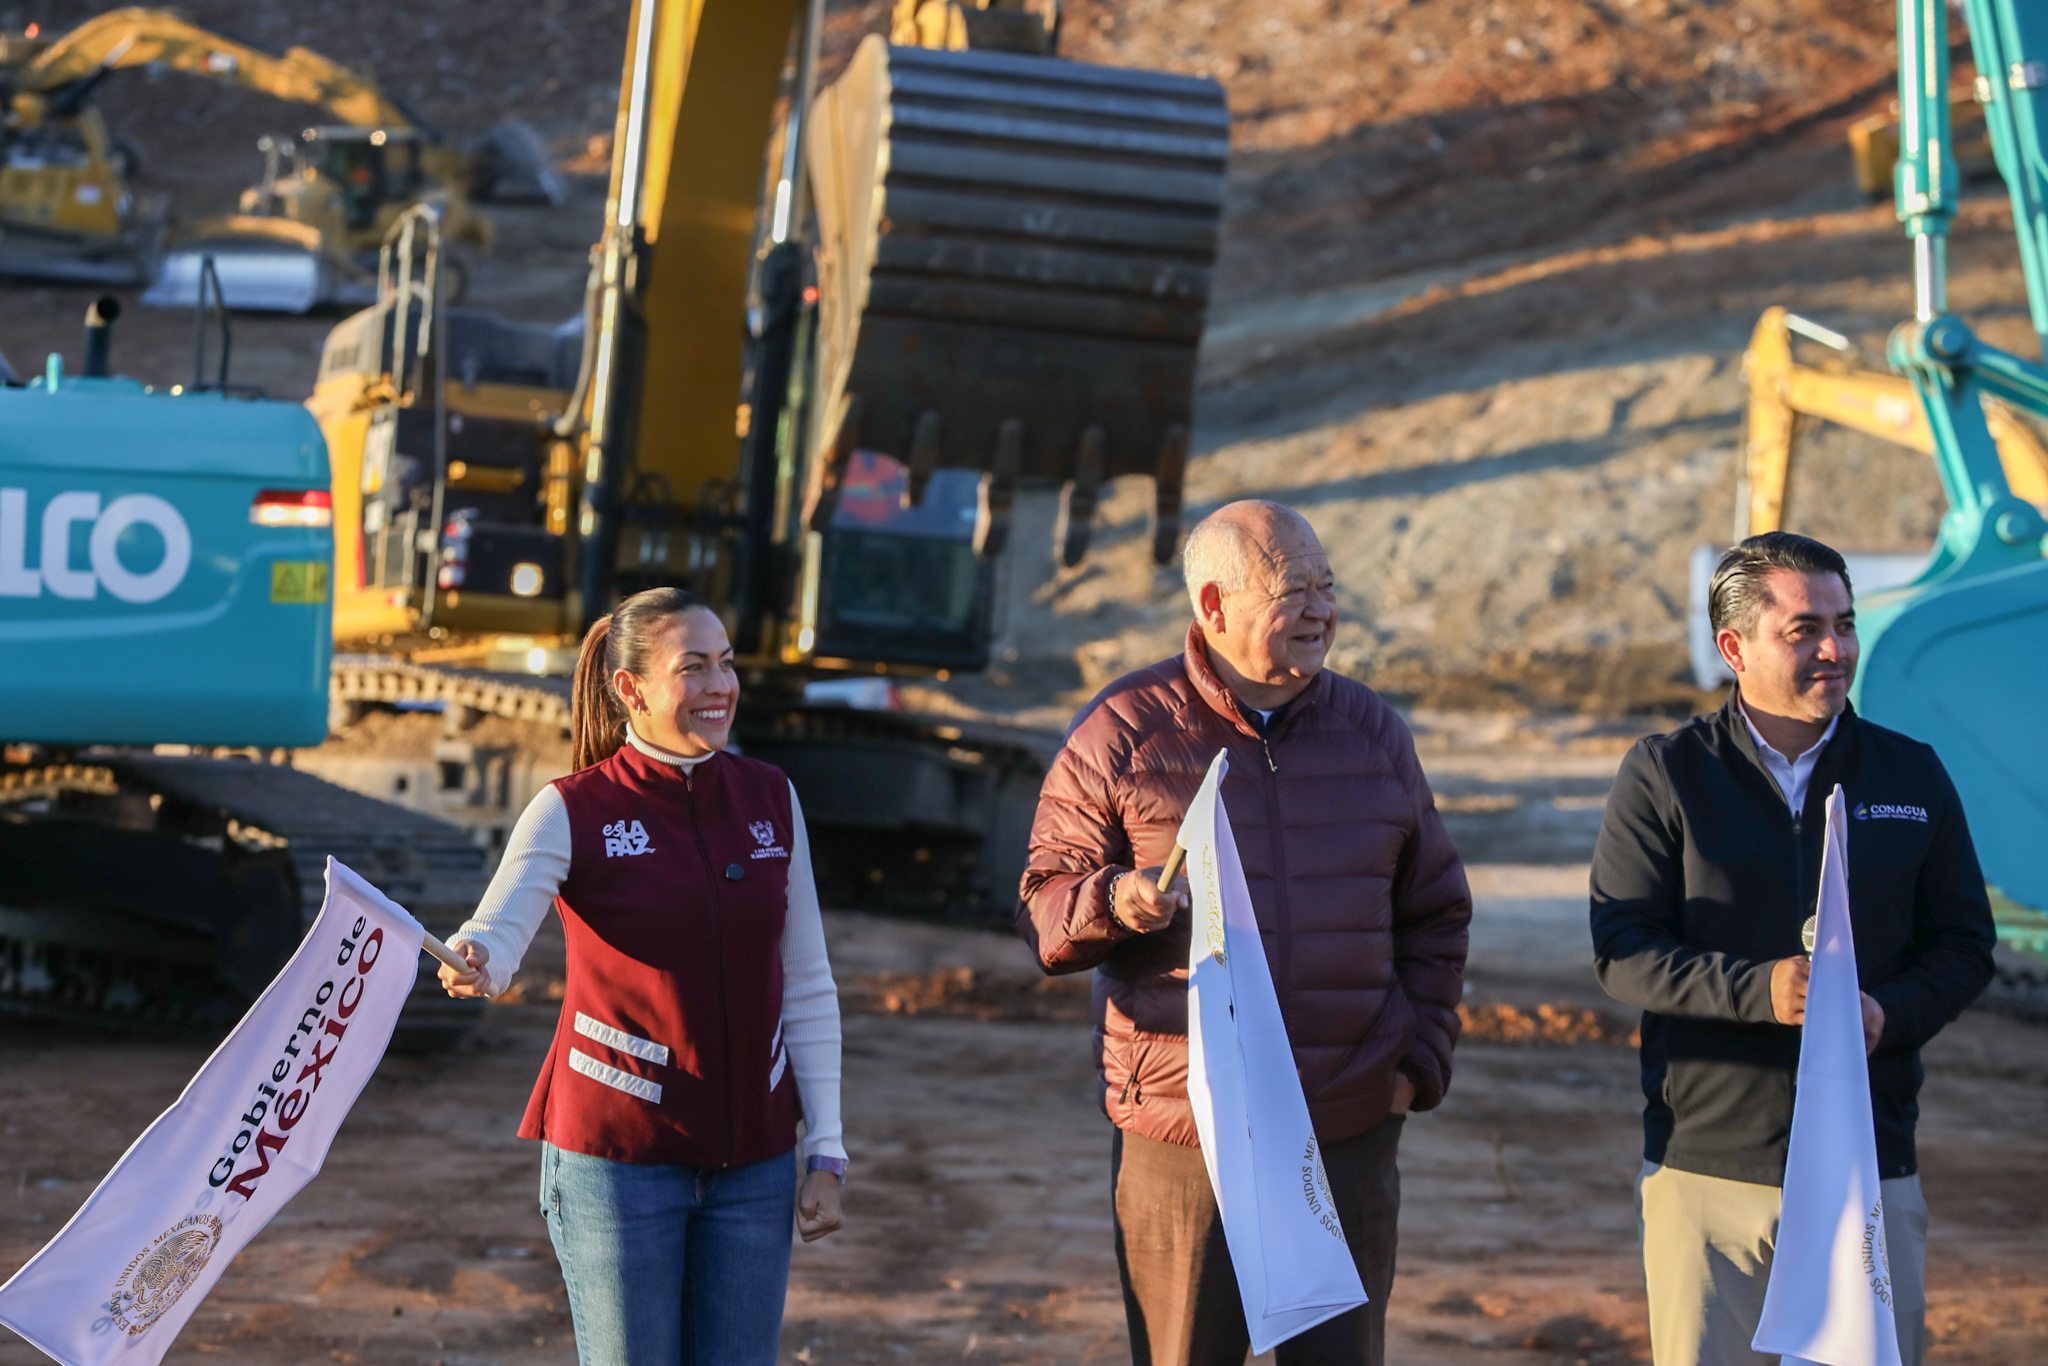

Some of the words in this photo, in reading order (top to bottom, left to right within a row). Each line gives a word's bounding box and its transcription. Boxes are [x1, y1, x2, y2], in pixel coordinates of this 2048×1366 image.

[602, 823, 624, 837] es
[617, 820, 650, 839] LA
[1870, 804, 1928, 817] CONAGUA
[605, 838, 656, 857] PAZ
[208, 981, 334, 1188] Gobierno
[337, 916, 367, 966] de
[225, 928, 383, 1202] México
[1302, 1166, 1322, 1215] UNIDOS
[153, 1214, 212, 1246] MEXICANOS
[1862, 1223, 1876, 1275] UNIDOS
[115, 1247, 150, 1288] UNIDOS
[110, 1291, 130, 1331] ESTADOS
